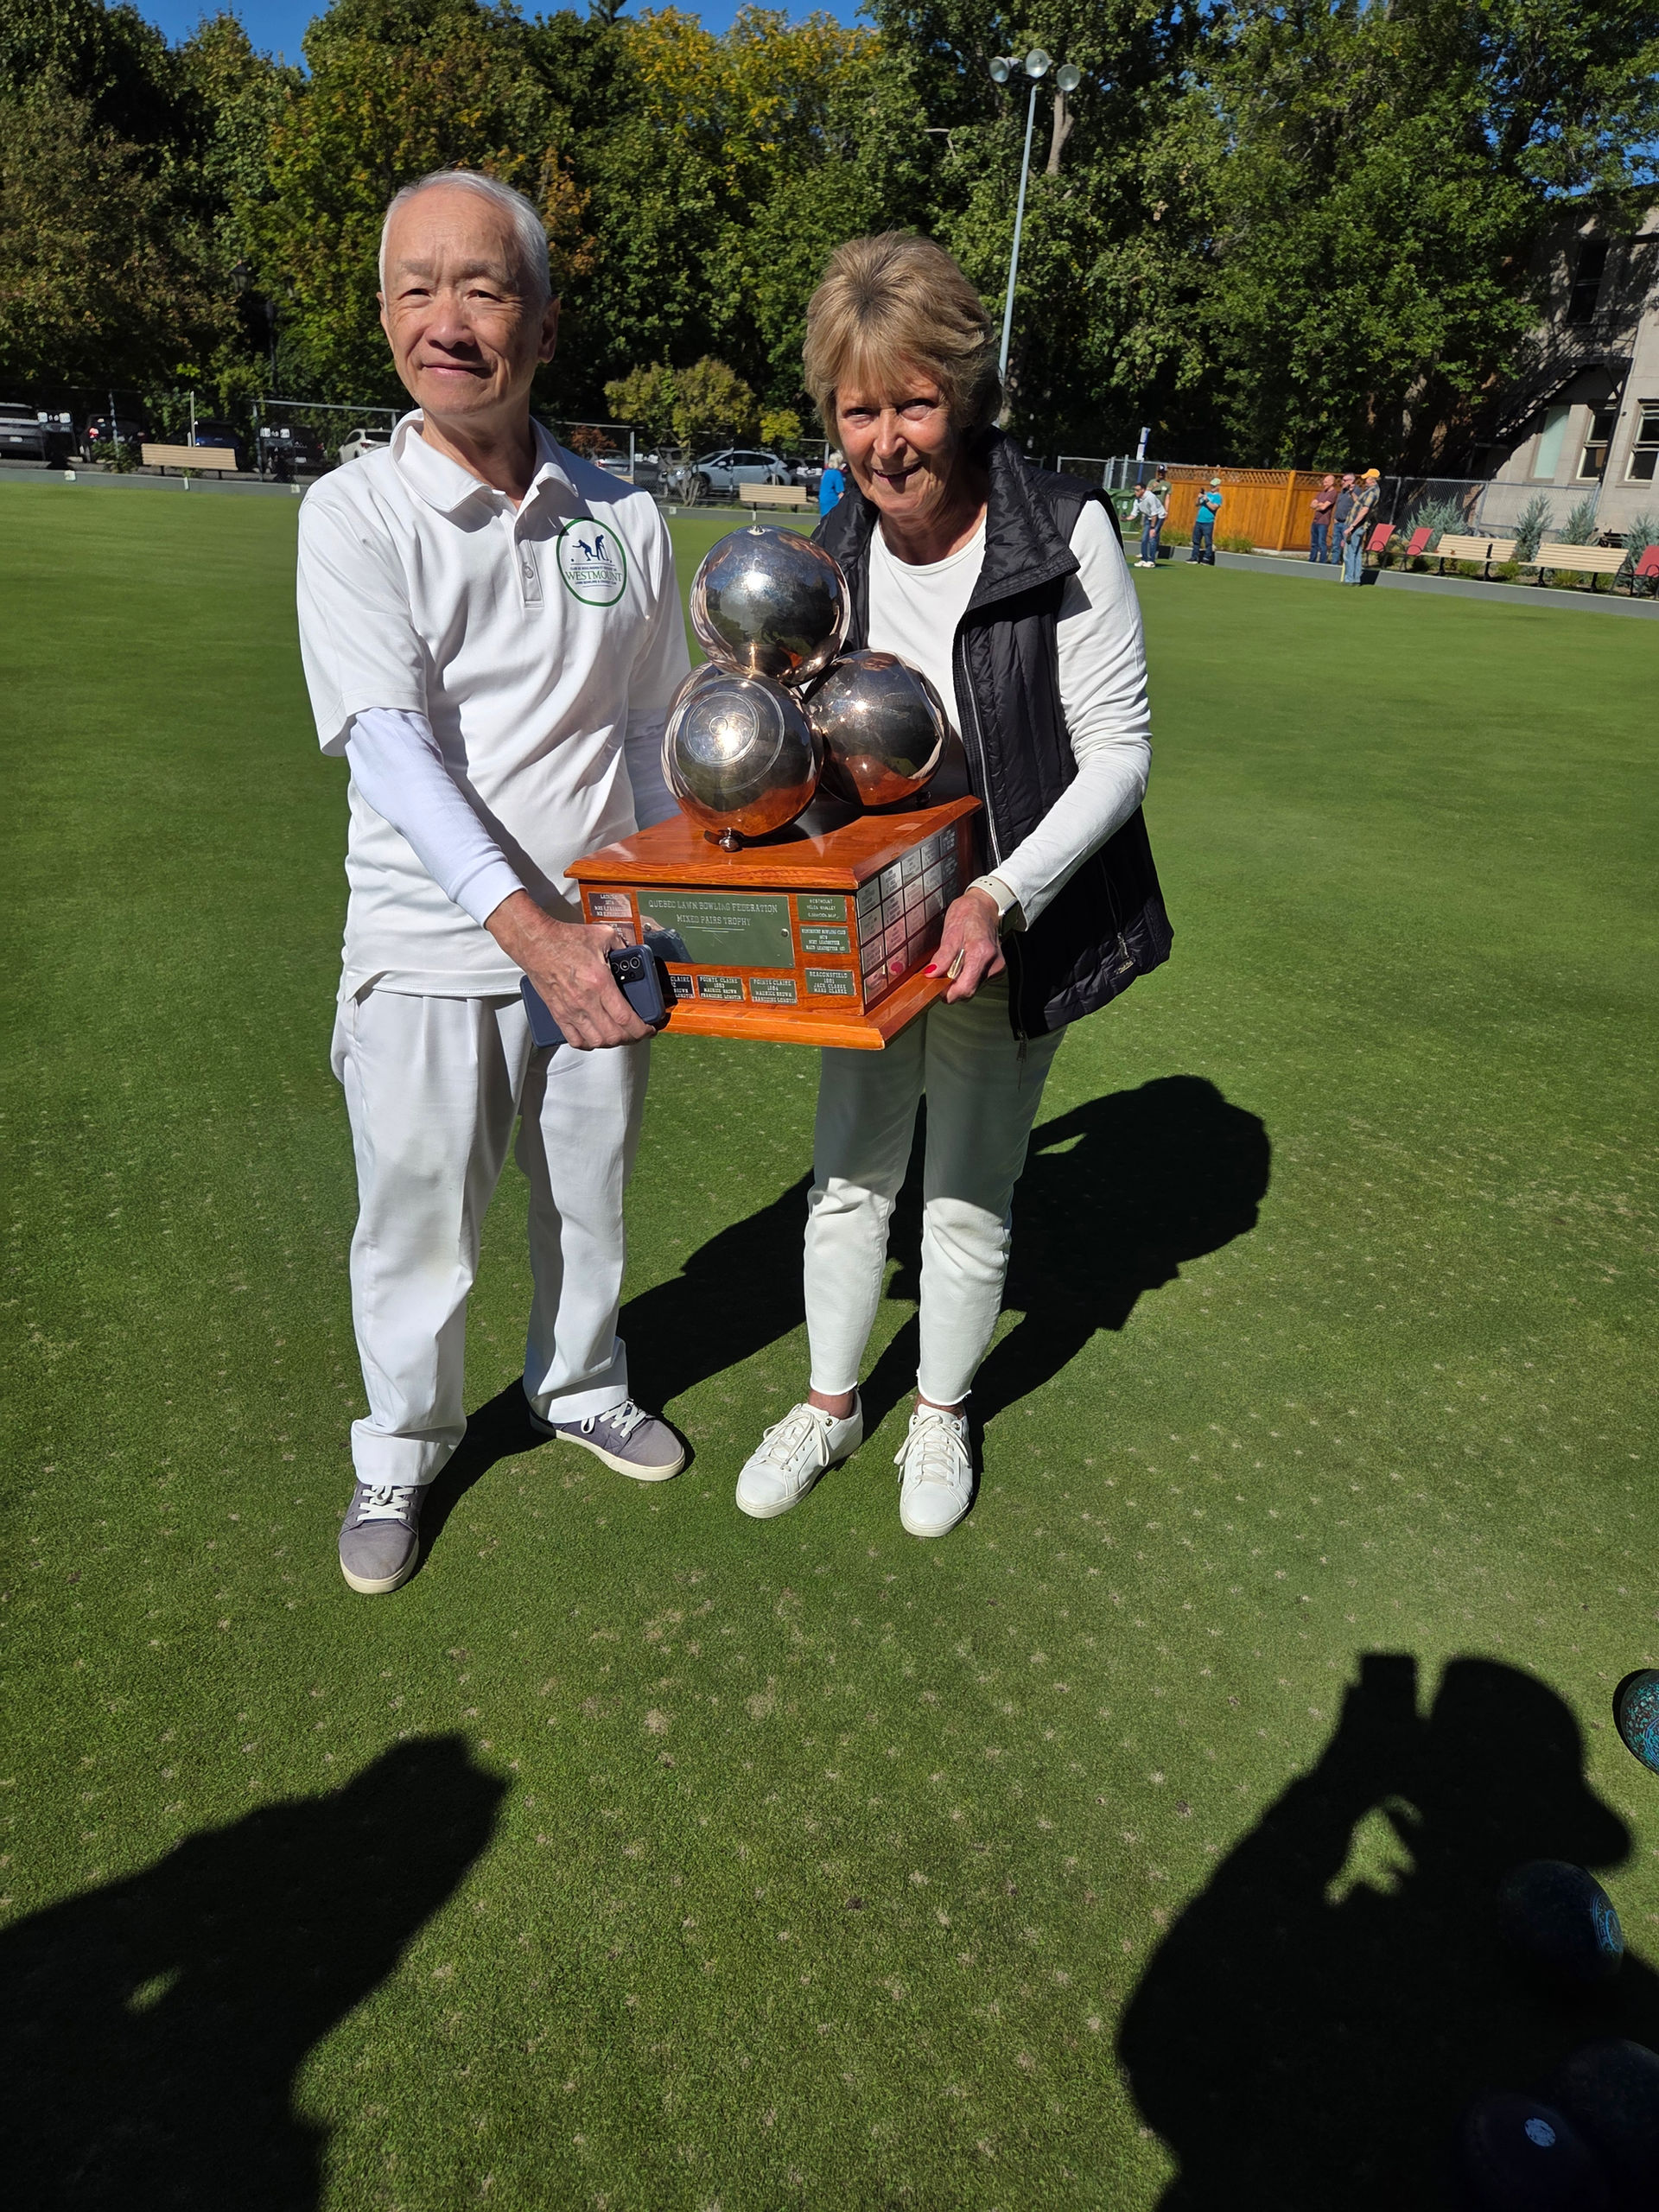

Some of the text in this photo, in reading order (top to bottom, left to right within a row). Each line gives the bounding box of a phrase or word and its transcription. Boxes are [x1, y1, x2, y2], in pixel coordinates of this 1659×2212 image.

[565, 570, 622, 582] WESTMOUNT
[648, 899, 778, 912] QUEBEC LAWN BOWLING FEDERATION
[676, 913, 752, 926] MIXED PAIRS TROPHY
